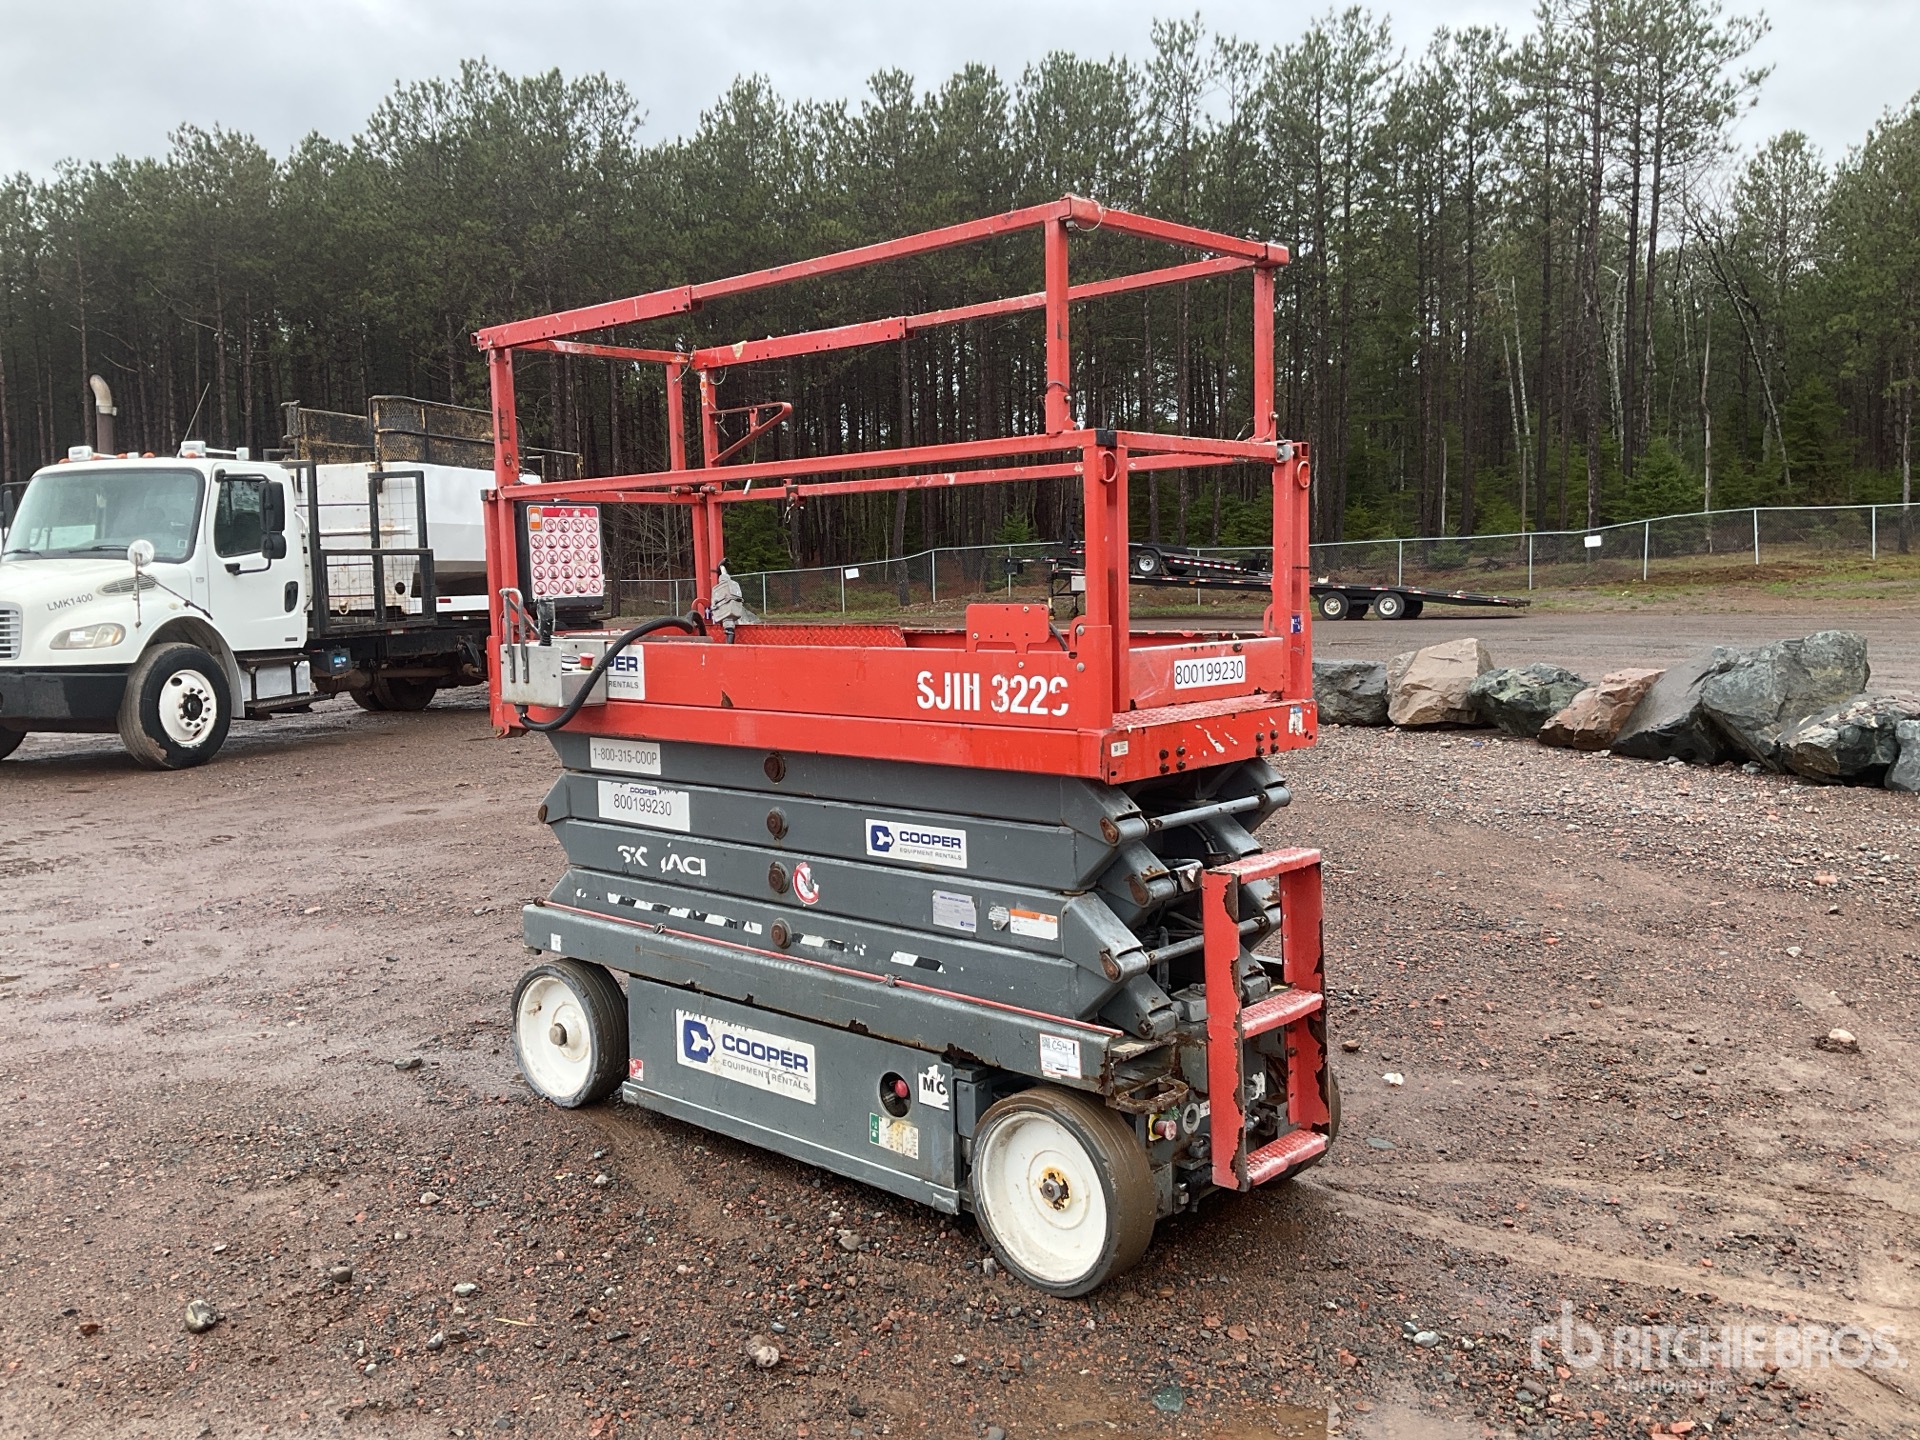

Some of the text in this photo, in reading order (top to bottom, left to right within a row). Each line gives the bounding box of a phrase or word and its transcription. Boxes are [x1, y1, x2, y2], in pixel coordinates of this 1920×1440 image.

[46, 593, 93, 611] LMK1400
[1175, 660, 1244, 685] 800199230
[629, 786, 657, 796] COOPER
[613, 793, 672, 816] 800199230
[899, 831, 962, 849] COOPER
[899, 847, 962, 860] EQUIPMENT RENTALS
[722, 1034, 809, 1073] COOPER
[722, 1059, 810, 1092] EQUIPMENT RENTALS
